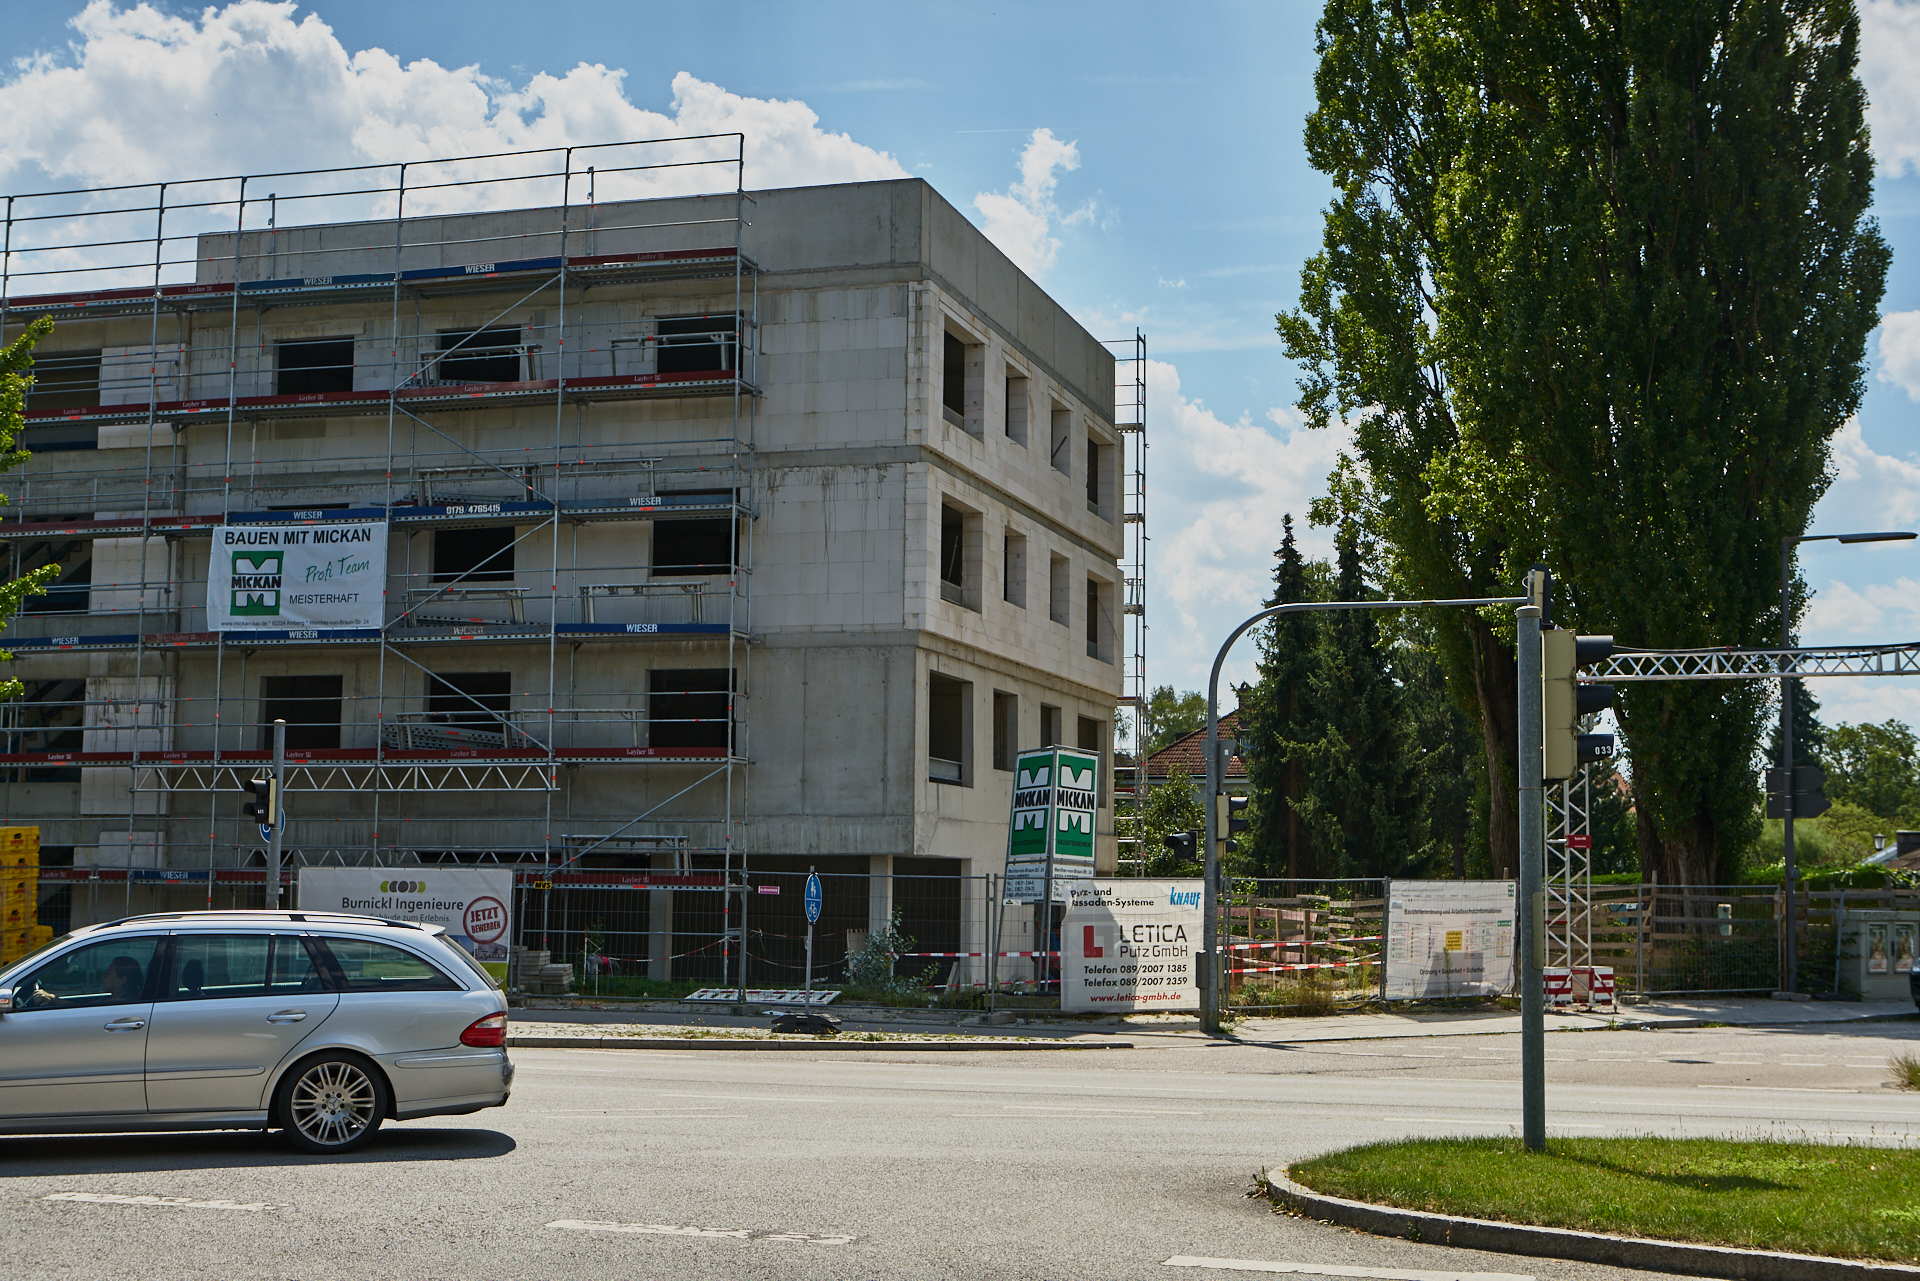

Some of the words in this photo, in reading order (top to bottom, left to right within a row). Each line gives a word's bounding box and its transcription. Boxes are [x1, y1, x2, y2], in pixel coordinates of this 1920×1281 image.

[465, 263, 495, 274] WIESER
[303, 276, 333, 286] WIESER
[629, 496, 661, 506] WIESER
[293, 511, 323, 520] WIESER
[225, 531, 279, 545] BAUEN
[283, 530, 309, 544] MIT
[313, 528, 371, 544] MICKAN
[305, 561, 334, 583] Profi
[337, 554, 370, 576] Team
[231, 575, 282, 589] MICKAN
[289, 593, 360, 605] MEISTERHAFT
[626, 623, 658, 633] WIESER
[288, 630, 318, 639] WIESER
[52, 636, 79, 645] WIESER
[1594, 745, 1612, 755] 033
[1014, 789, 1050, 809] MICKAN
[1057, 789, 1095, 810] MICKAN
[159, 871, 189, 880] WIESER
[535, 881, 551, 889] MVS
[1093, 886, 1112, 896] und
[342, 897, 392, 909] Burnickl
[395, 898, 464, 913] Ingenieure
[420, 913, 452, 923] Erlebnis.
[470, 906, 499, 923] JETZT
[471, 920, 501, 934] BEWERBEN
[1120, 924, 1188, 943] LETICA
[1120, 945, 1149, 958] Putz
[1152, 944, 1188, 957] GmbH
[1084, 964, 1117, 975] Telefon
[1119, 964, 1164, 975] 089/2007
[1166, 964, 1187, 973] 1385
[1084, 977, 1117, 987] Telefax
[1119, 977, 1164, 987] 089/2007
[1166, 976, 1188, 986] 2359
[1090, 992, 1181, 1003] www.letica-gmbh.de
